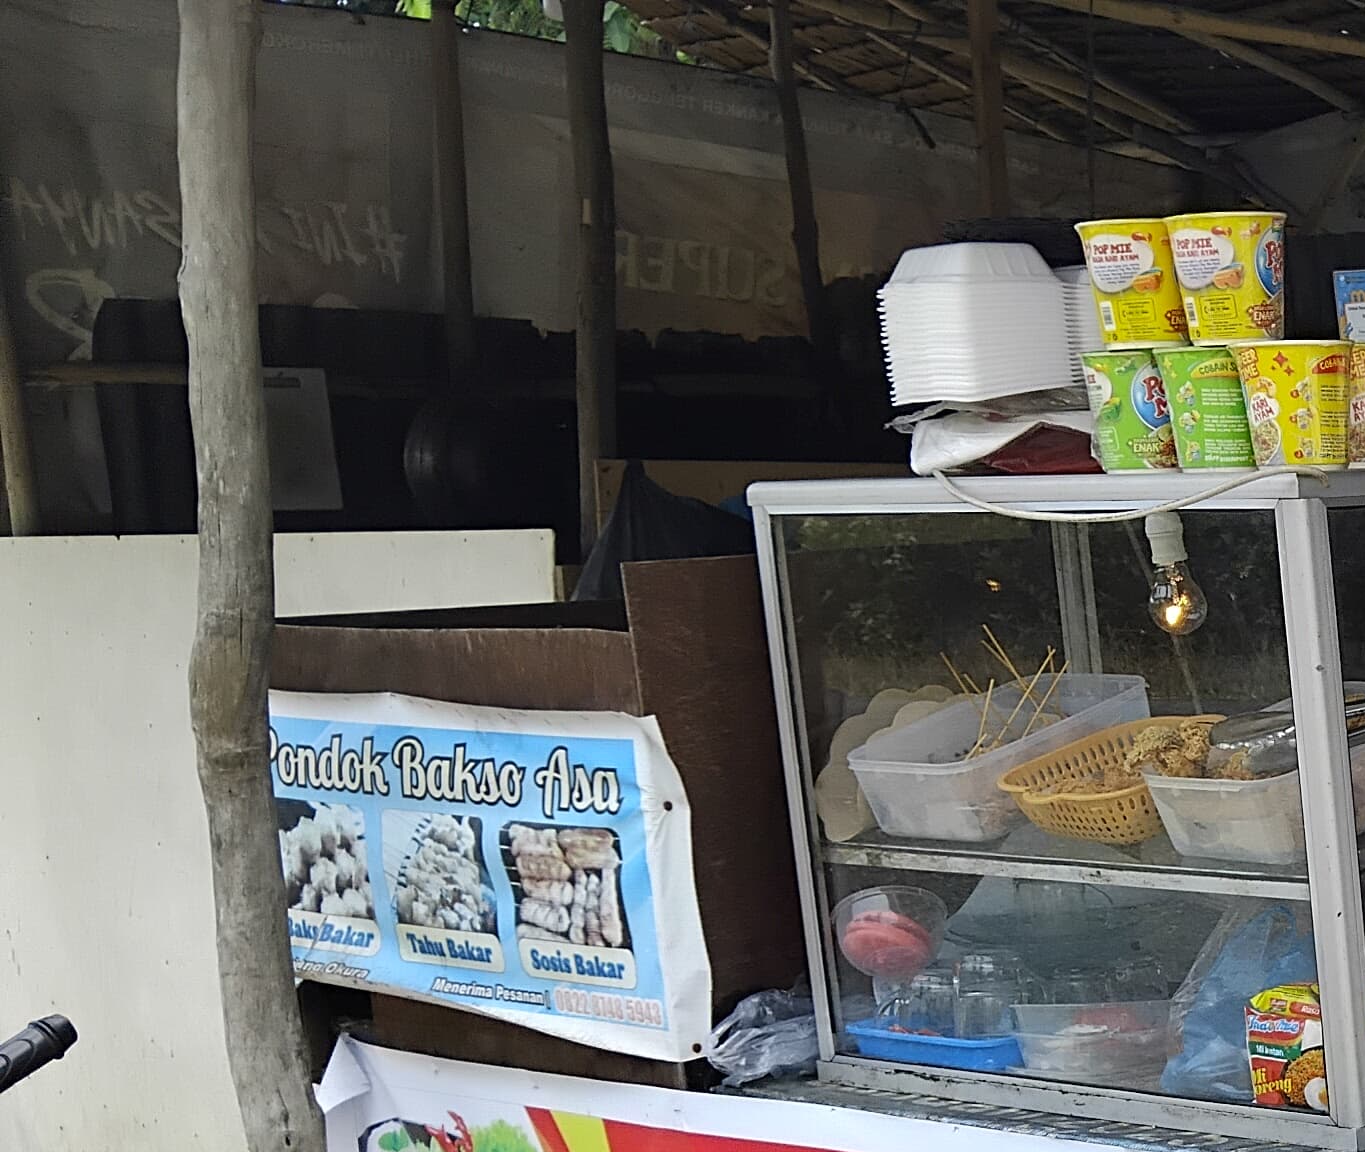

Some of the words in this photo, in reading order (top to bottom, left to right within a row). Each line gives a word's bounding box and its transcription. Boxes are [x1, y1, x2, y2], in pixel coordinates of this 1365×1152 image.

[392, 736, 524, 807] Bakso
[535, 747, 624, 816] Asa
[406, 932, 442, 957] Tahu
[445, 936, 493, 963] Bakar
[530, 949, 572, 973] Sosis
[575, 953, 625, 979] Bakar
[432, 977, 493, 999] Menerima
[495, 984, 545, 1005] Pesanan
